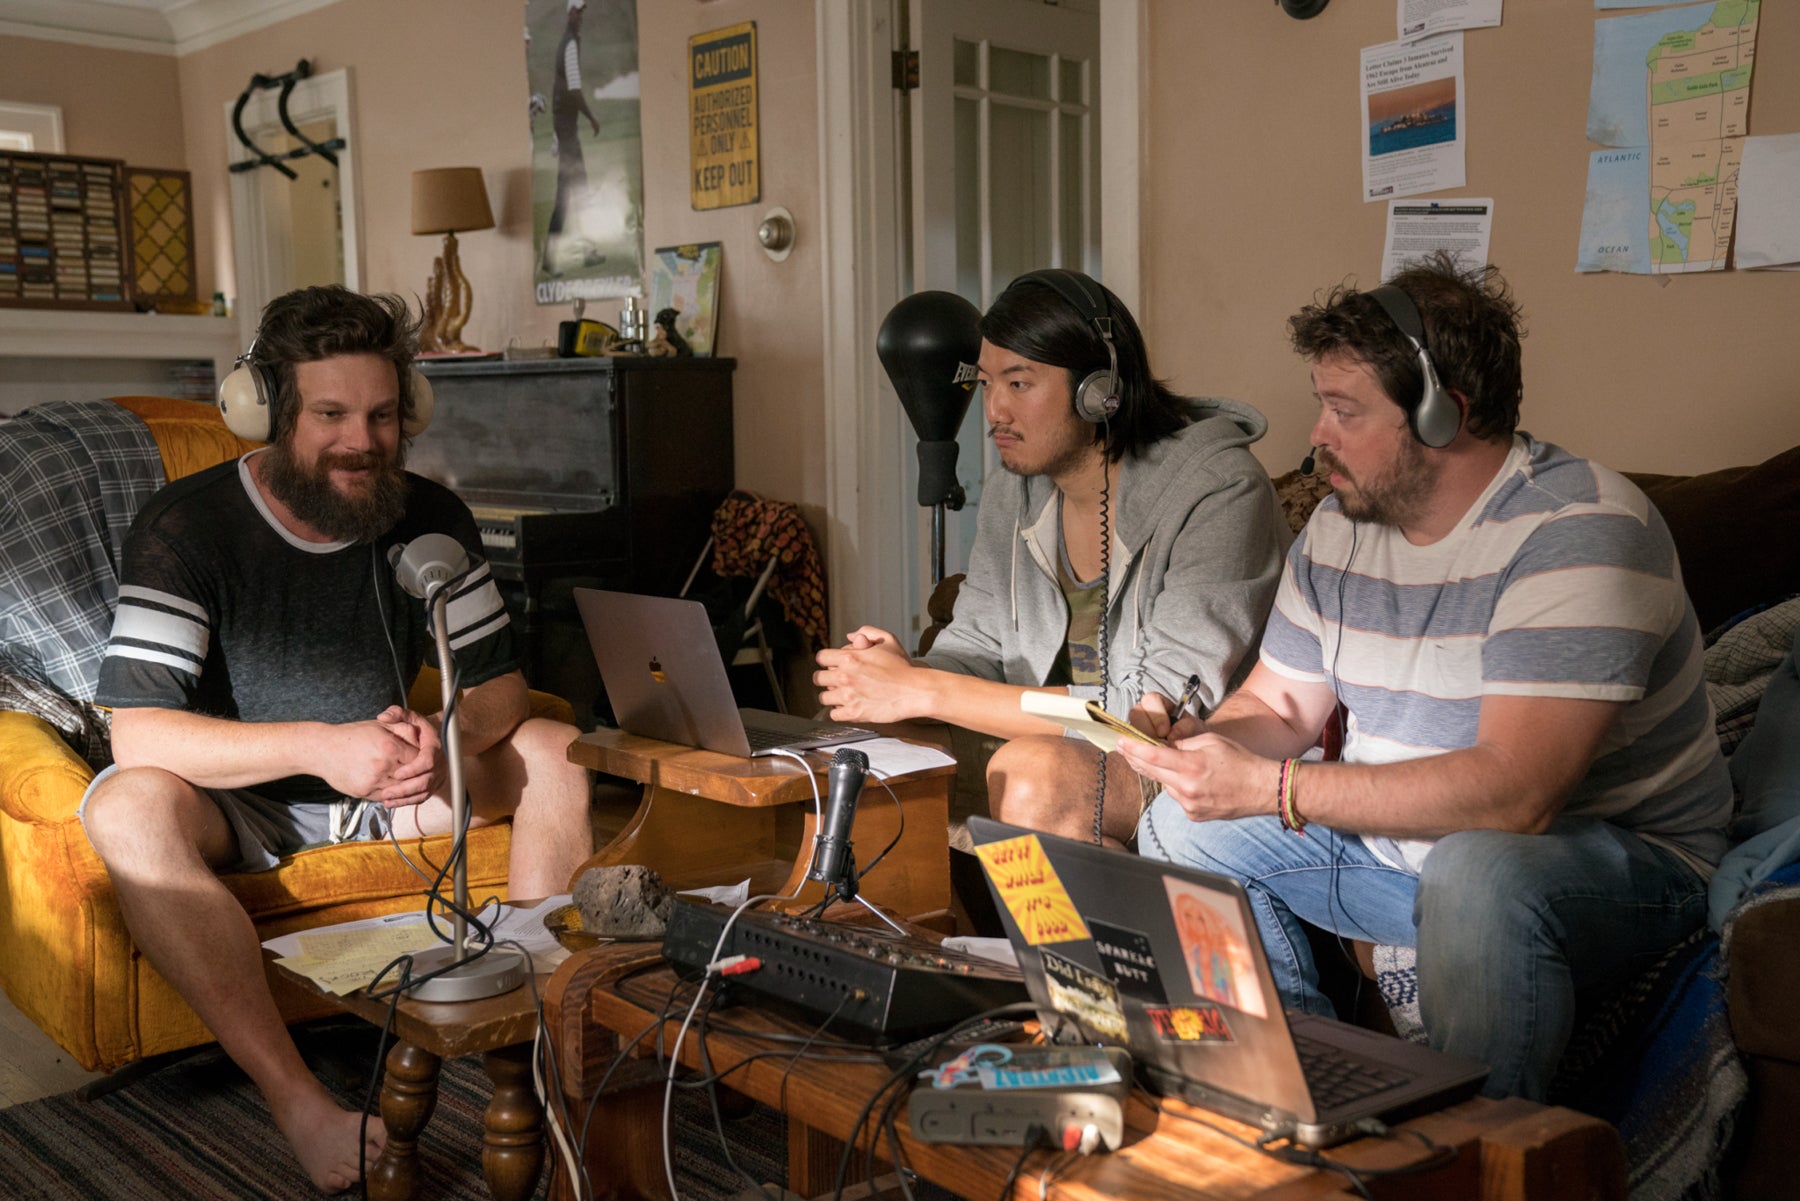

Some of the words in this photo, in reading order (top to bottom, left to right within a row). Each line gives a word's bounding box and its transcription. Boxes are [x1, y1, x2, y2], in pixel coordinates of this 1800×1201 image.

[695, 42, 749, 79] CAUTION
[1365, 62, 1382, 72] Letter
[1382, 59, 1402, 68] Claims
[1407, 53, 1429, 62] Inmates
[1430, 45, 1454, 56] Survived
[1366, 71, 1378, 80] 1962
[1379, 68, 1398, 78] Escape
[1399, 65, 1413, 73] from
[1414, 60, 1436, 70] Alcatraz
[1437, 56, 1448, 64] and
[1366, 81, 1376, 89] Are
[1377, 77, 1389, 86] Still
[1389, 75, 1403, 84] Alive
[1404, 72, 1420, 82] Today
[694, 84, 752, 114] AUTHORIZED
[694, 107, 753, 136] PERSONNEL
[710, 131, 735, 155] ONLY
[1597, 152, 1642, 164] ATLANTIC
[694, 163, 725, 192] KEEP
[729, 160, 753, 187] OUT
[1597, 246, 1629, 254] OCEAN
[536, 280, 574, 304] CLYDE
[1045, 952, 1075, 980] Did
[1095, 940, 1156, 969] SPARKLE
[1114, 962, 1148, 982] BUTT
